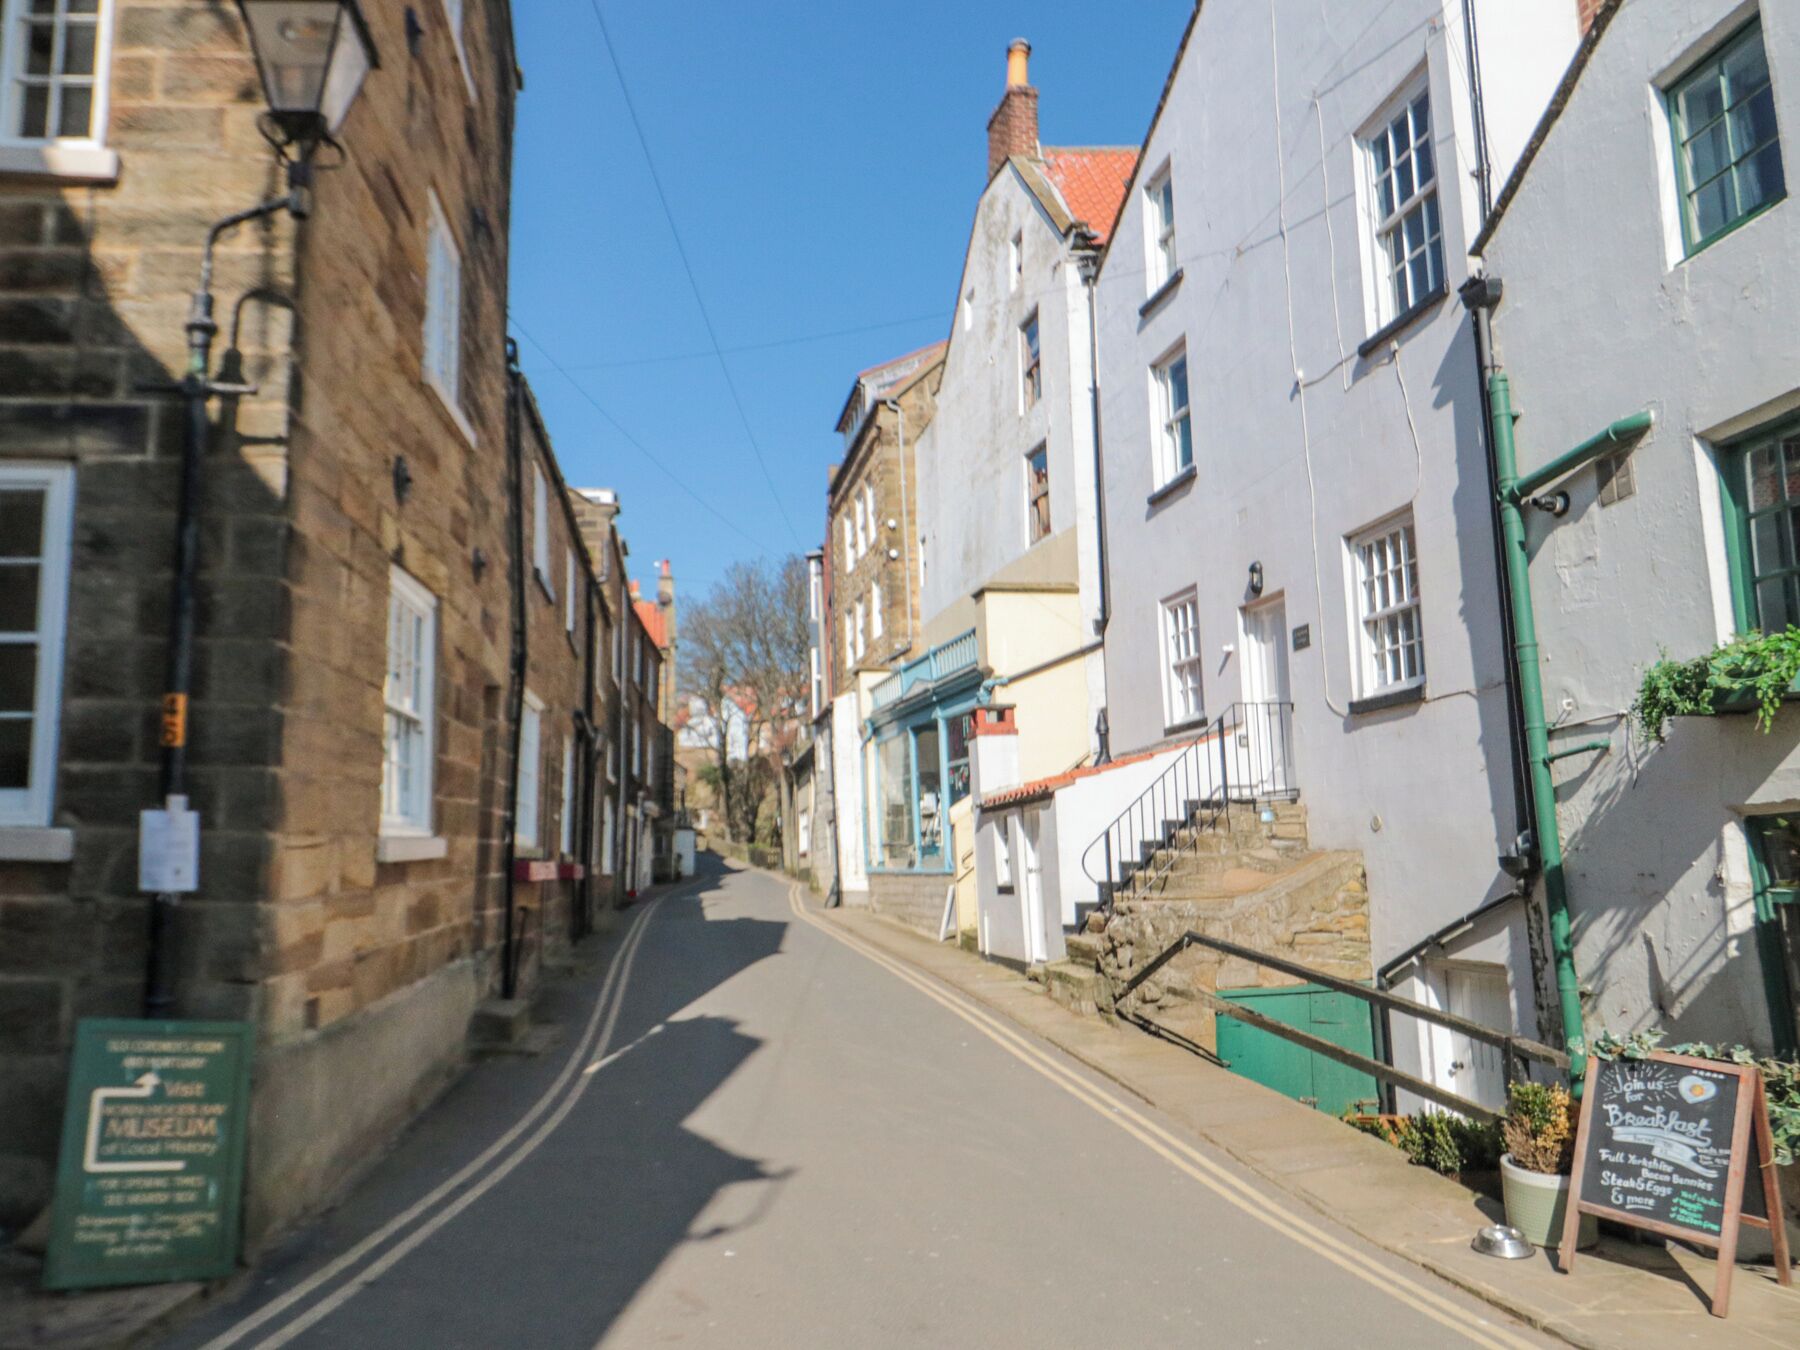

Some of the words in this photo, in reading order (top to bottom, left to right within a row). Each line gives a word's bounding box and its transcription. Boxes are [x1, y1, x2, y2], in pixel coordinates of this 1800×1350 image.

[166, 1082, 204, 1097] Visit
[1613, 1074, 1645, 1094] Join
[1647, 1080, 1664, 1091] us
[1625, 1091, 1645, 1103] for
[105, 1117, 217, 1138] MUSEUM
[1602, 1104, 1713, 1140] Breakfast
[164, 1141, 217, 1156] History
[1599, 1149, 1625, 1163] Full
[1641, 1168, 1671, 1182] Bacon
[1626, 1194, 1656, 1206] more
